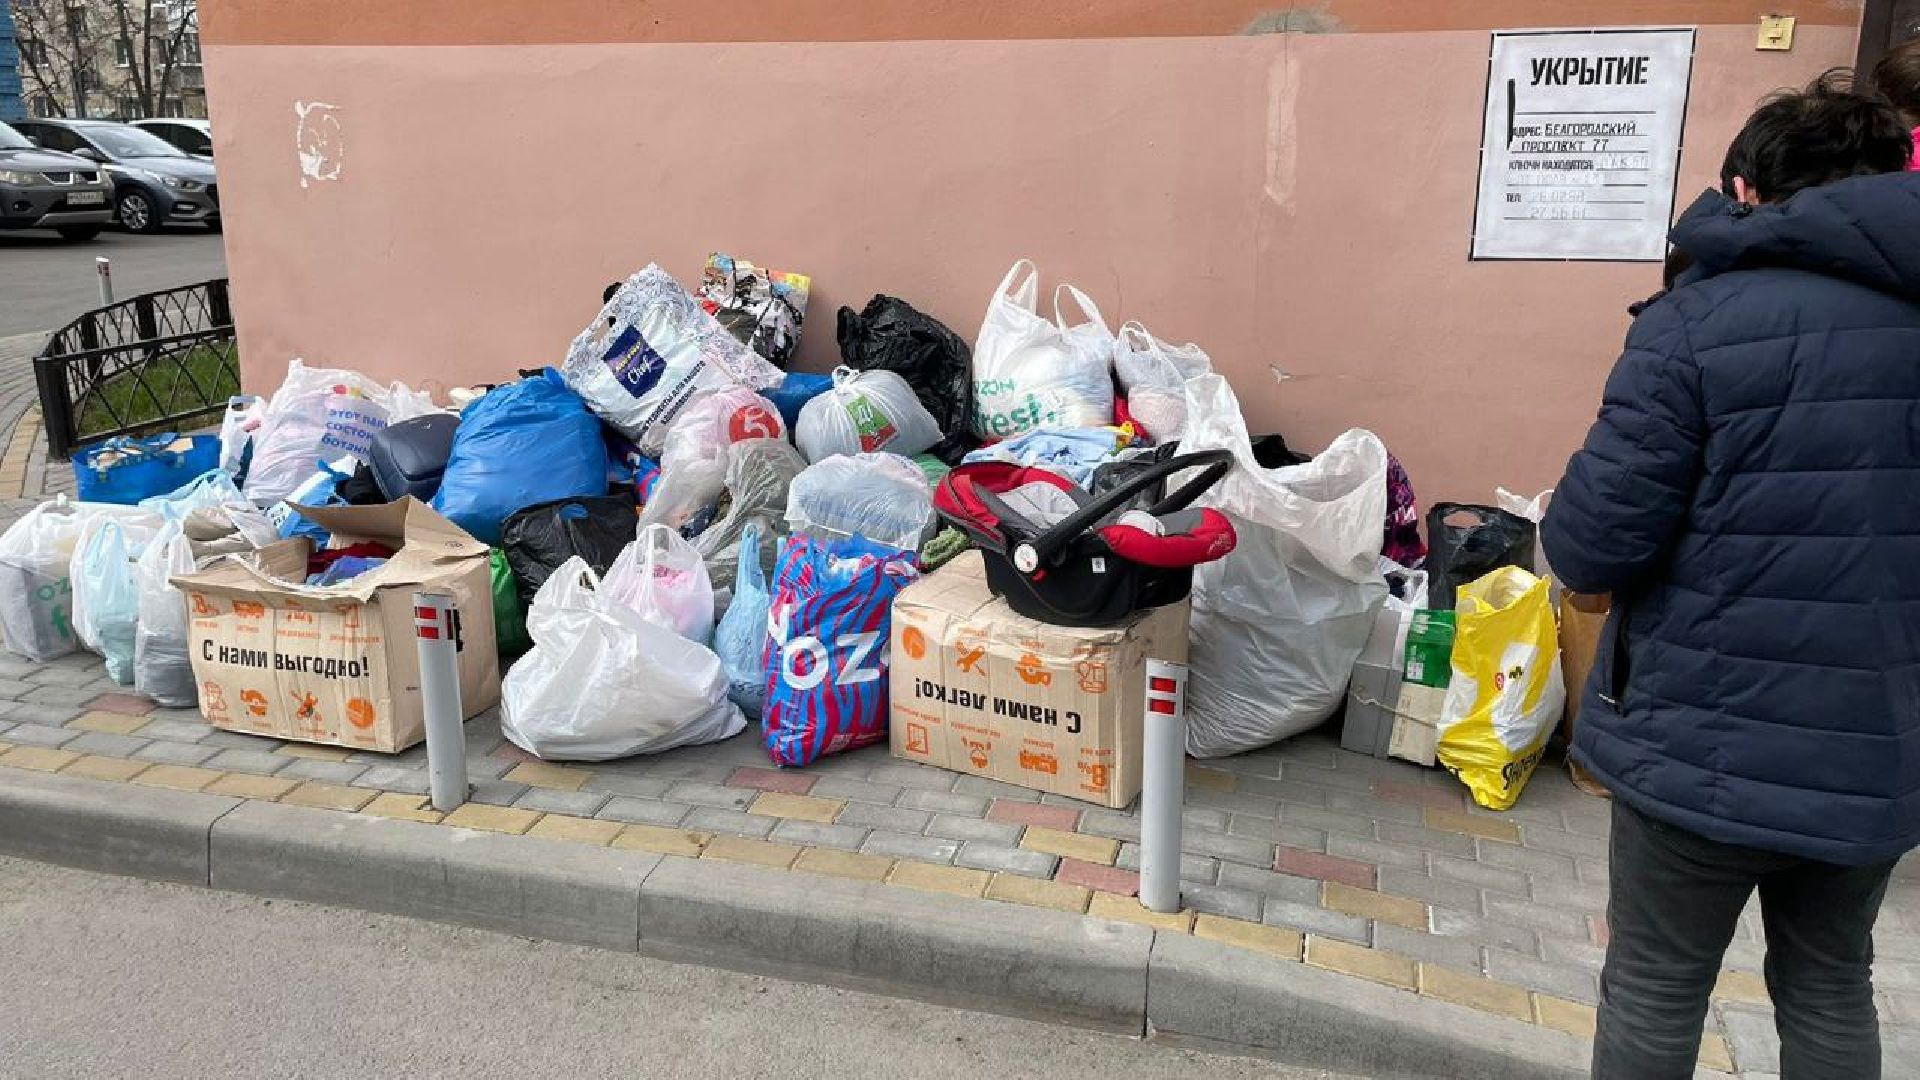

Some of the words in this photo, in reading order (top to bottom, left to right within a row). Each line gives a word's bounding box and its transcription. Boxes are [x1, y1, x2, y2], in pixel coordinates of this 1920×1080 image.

[1530, 56, 1651, 86] УКРЫТИЕ
[1593, 138, 1610, 152] 77
[203, 639, 213, 661] С
[219, 645, 268, 669] нами
[274, 653, 370, 680] выгодно!
[915, 677, 986, 711] легко!
[993, 697, 1057, 727] нами
[1065, 711, 1081, 734] С
